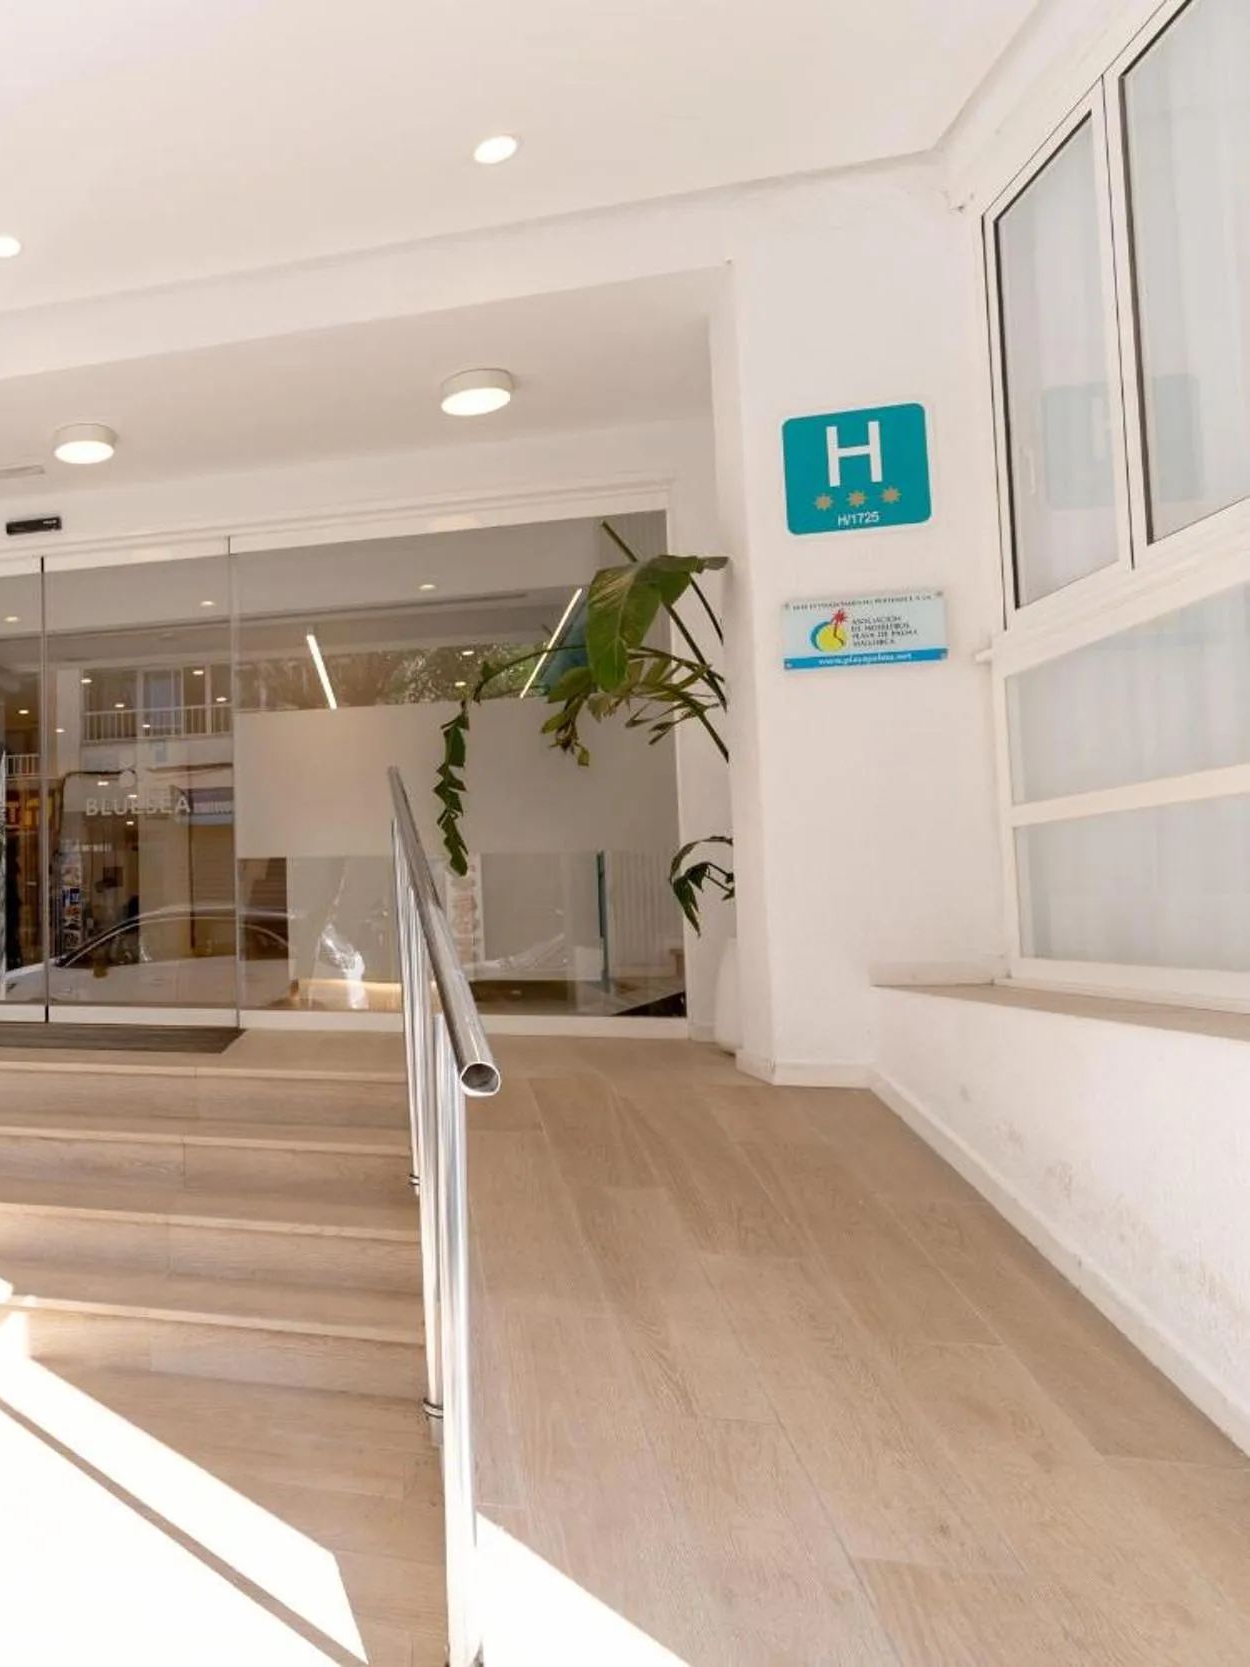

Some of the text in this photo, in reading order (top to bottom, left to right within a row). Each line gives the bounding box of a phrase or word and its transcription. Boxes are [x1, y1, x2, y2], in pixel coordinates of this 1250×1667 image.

[826, 420, 883, 487] H
[837, 511, 880, 527] H/1725
[85, 796, 191, 817] BLUESEA
